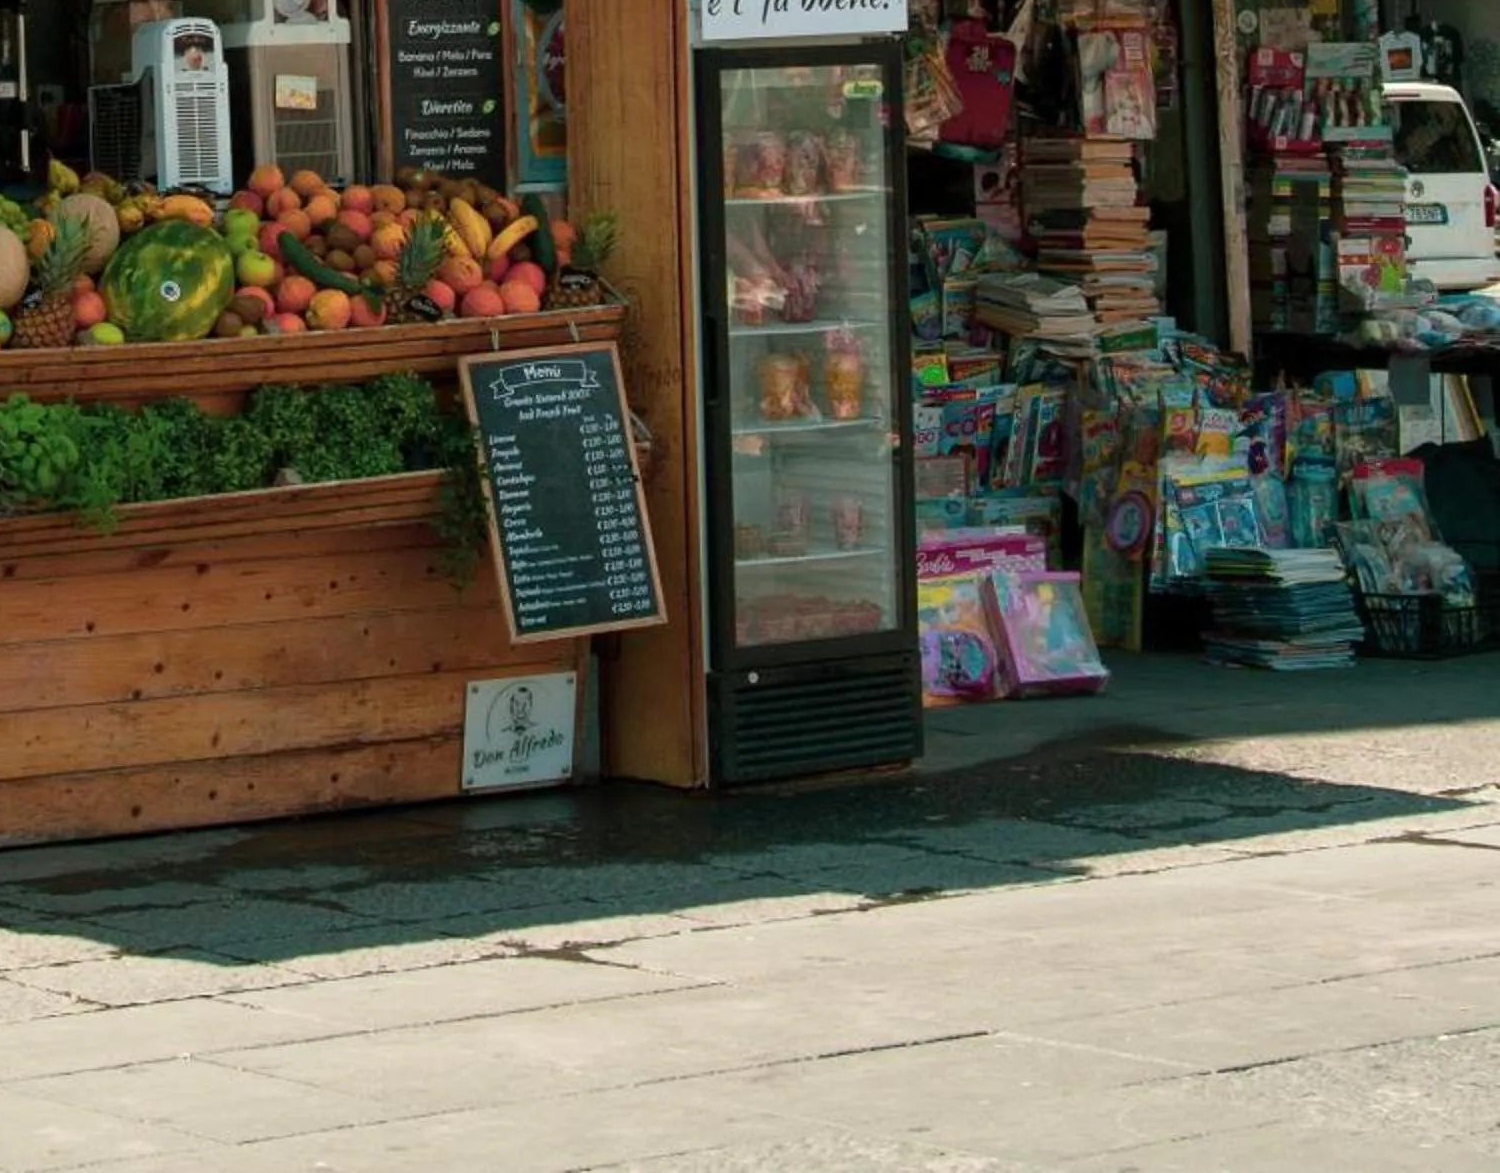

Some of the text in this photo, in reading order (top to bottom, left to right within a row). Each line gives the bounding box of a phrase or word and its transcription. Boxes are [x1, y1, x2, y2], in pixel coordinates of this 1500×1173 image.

[523, 364, 562, 380] Menù
[473, 728, 565, 769] Don Alfredo
